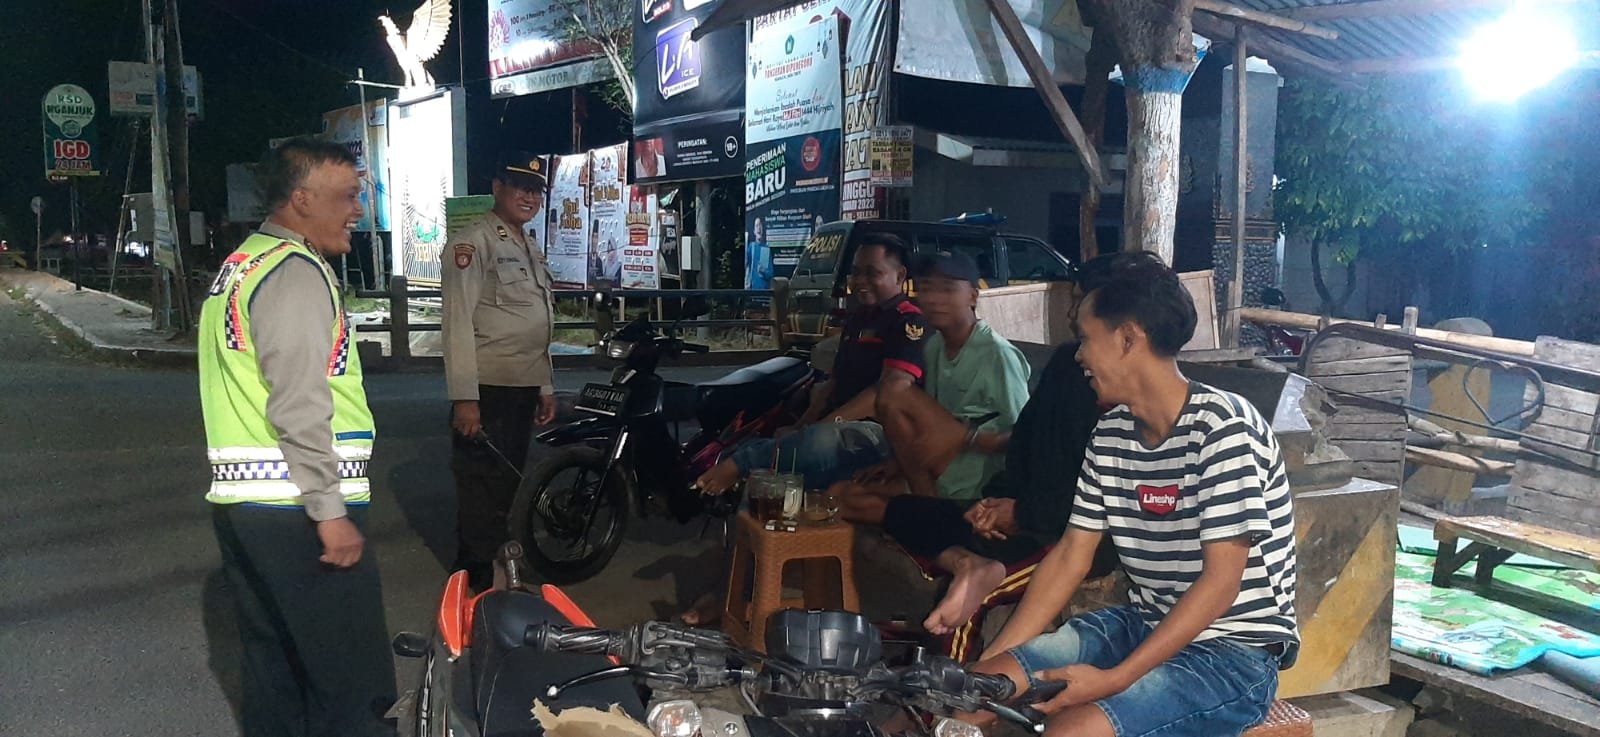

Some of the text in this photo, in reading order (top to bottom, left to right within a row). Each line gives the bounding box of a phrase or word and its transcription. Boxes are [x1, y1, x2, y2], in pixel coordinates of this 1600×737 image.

[682, 68, 695, 77] ICE
[46, 104, 93, 115] NGANJUK
[54, 139, 90, 159] IGD
[746, 141, 787, 172] PENERIMAAN
[746, 154, 786, 183] MAHASISWA
[746, 166, 786, 205] BARU
[858, 198, 875, 210] 2023
[809, 234, 842, 253] POLISI
